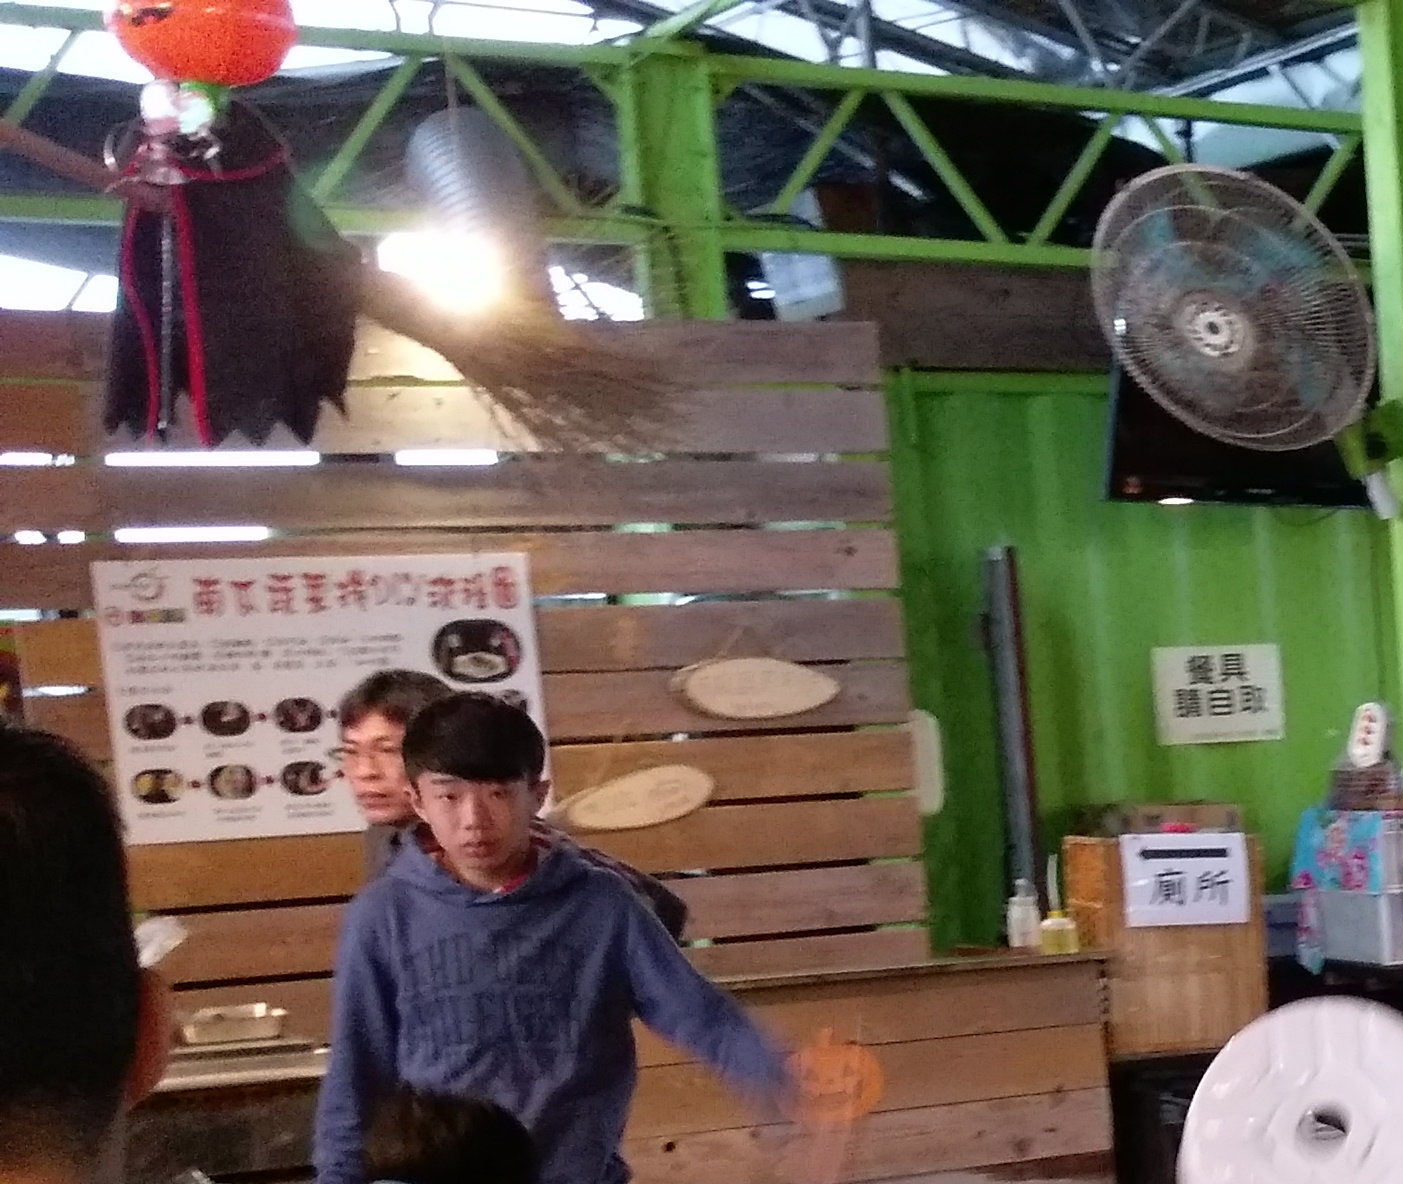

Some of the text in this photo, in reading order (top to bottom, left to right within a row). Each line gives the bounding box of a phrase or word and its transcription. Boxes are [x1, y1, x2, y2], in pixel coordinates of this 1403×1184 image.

[1186, 653, 1249, 685] 餐具
[1173, 685, 1269, 718] 請自取
[1149, 868, 1232, 906] 廁所
